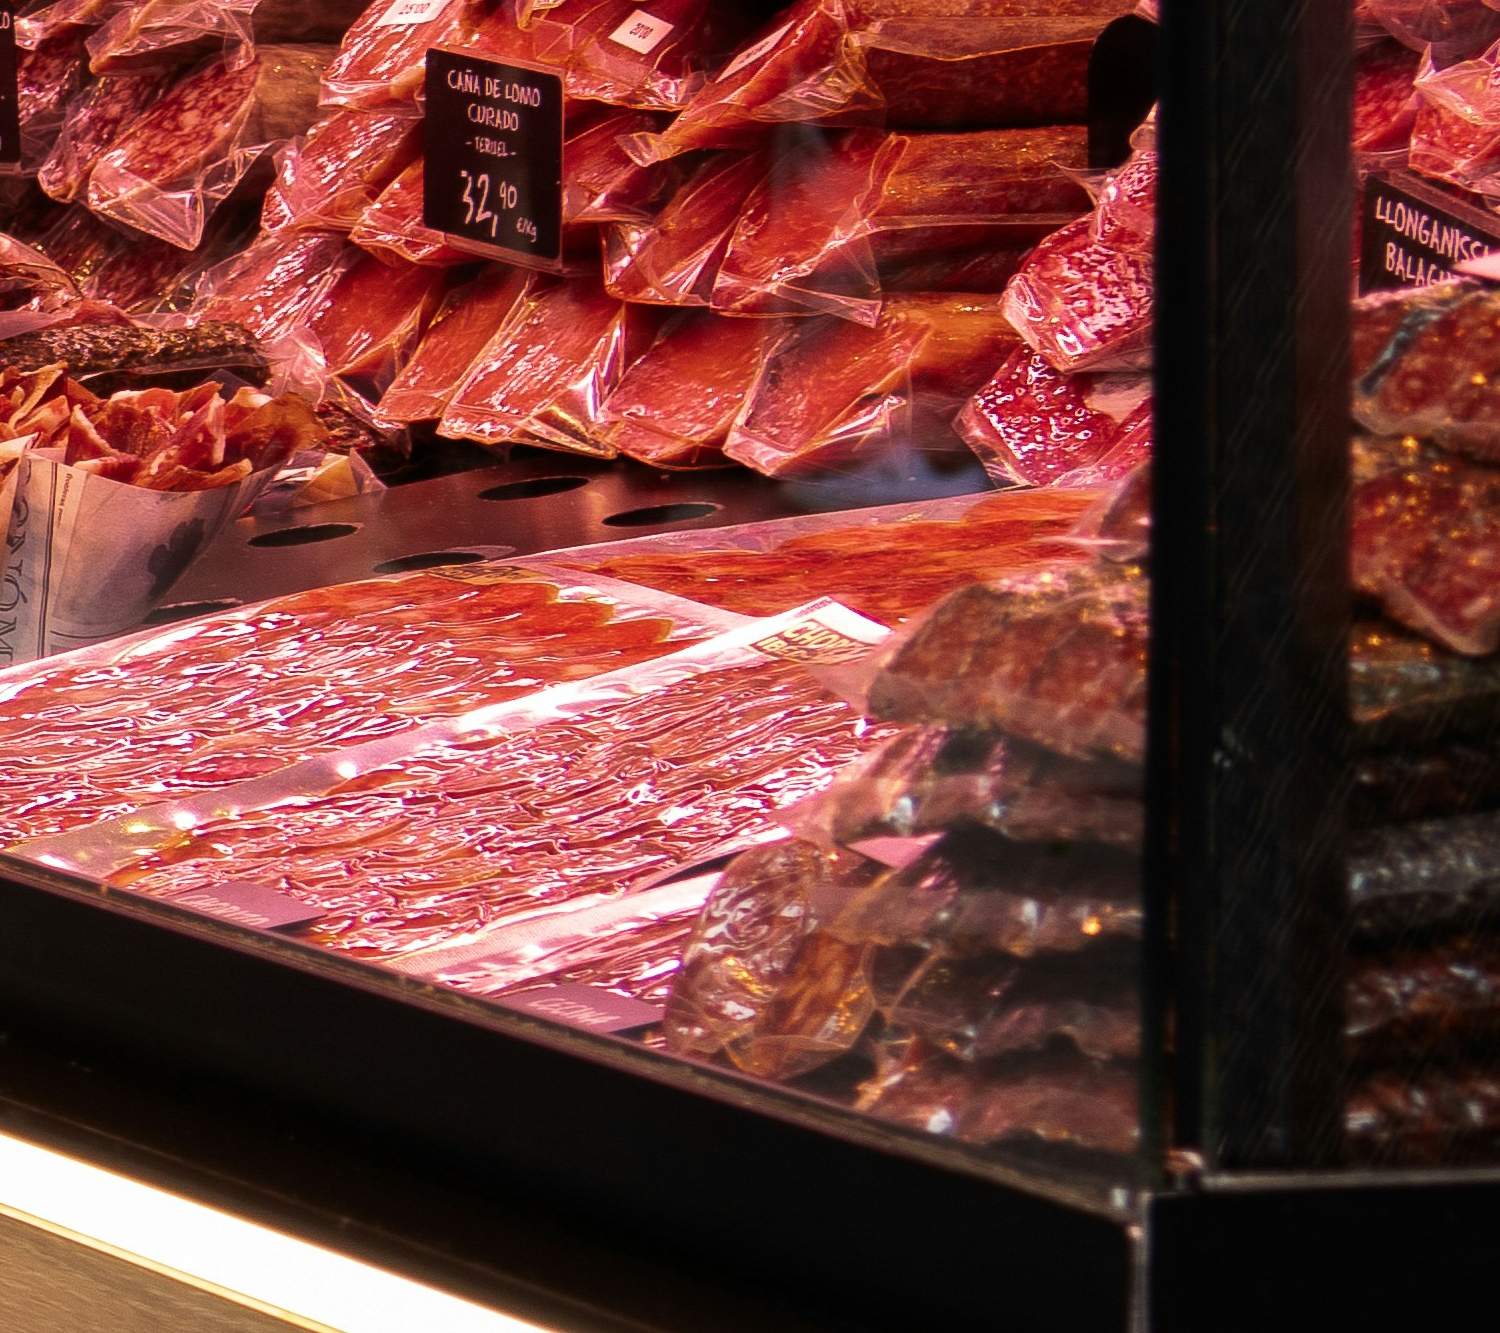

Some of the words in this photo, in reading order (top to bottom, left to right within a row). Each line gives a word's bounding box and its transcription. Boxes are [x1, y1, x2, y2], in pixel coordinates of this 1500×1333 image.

[447, 68, 481, 97] CAÑA
[484, 76, 502, 100] DE
[504, 83, 541, 108] LOMO
[466, 102, 519, 132] CURADO
[474, 136, 508, 157] TERUEL
